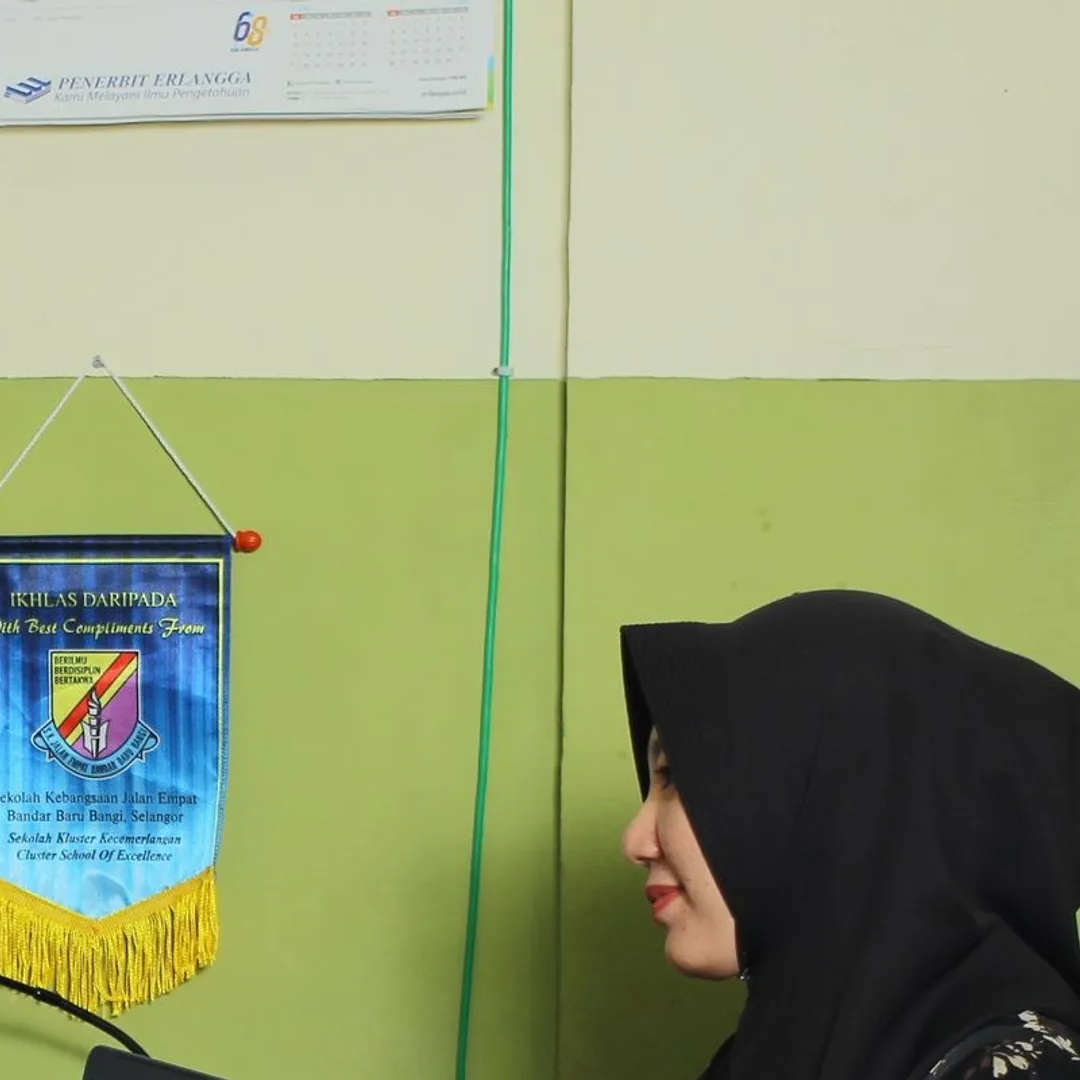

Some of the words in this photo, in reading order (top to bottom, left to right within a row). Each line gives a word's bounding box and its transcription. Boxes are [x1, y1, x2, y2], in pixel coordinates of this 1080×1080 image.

[58, 74, 150, 90] PENERBIT
[153, 71, 252, 87] ERLANGGA
[54, 92, 84, 102] Kami
[86, 89, 140, 103] Melayani
[172, 87, 250, 101] Pengetahuan
[10, 592, 77, 608] IKHLAS
[83, 591, 177, 608] DARIPADA
[24, 618, 57, 635] Best
[63, 618, 154, 640] Compliments
[158, 617, 205, 639] From
[54, 656, 88, 665] BERILMU
[54, 666, 101, 675] BERDISIPLIN
[45, 790, 118, 807] Kebangsaan
[121, 791, 153, 805] Jalan
[158, 792, 198, 807] Empat
[7, 809, 52, 823] Bandar
[56, 809, 85, 823] Baru
[131, 809, 185, 825] Selangor
[7, 832, 52, 844] Sekolah
[56, 832, 96, 844] Kluster
[99, 832, 182, 846] Kecemerlangan
[16, 849, 57, 861] Cluster
[59, 849, 96, 861] School
[99, 848, 114, 862] Of
[116, 849, 173, 861] Excellence
